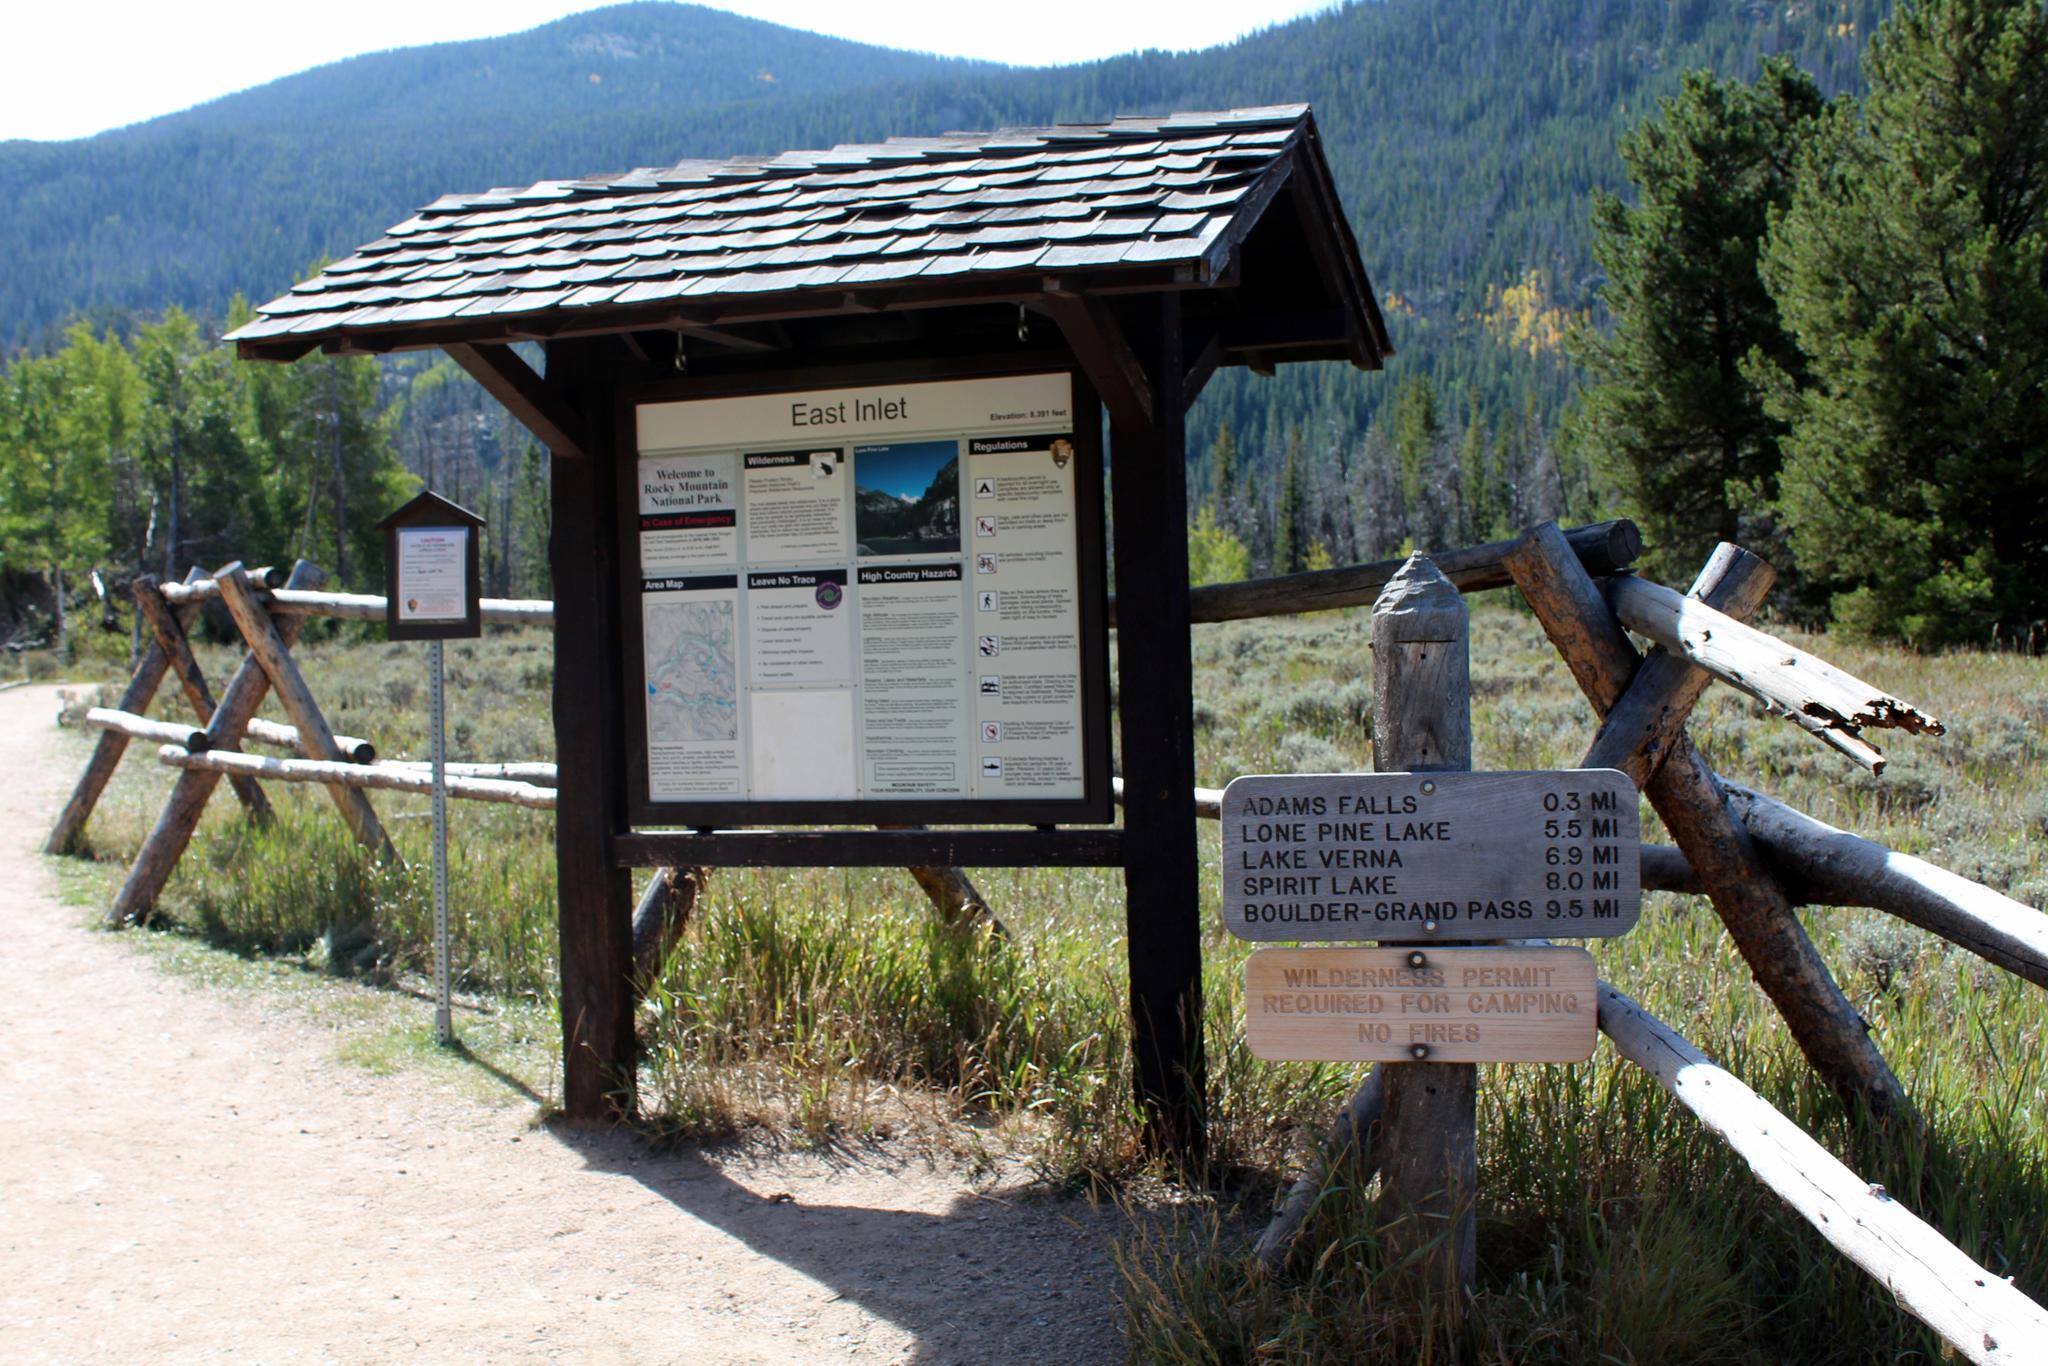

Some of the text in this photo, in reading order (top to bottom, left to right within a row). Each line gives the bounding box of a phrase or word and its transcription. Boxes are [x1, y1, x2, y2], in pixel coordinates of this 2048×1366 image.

[792, 397, 907, 426] East Inlet
[990, 412, 1026, 421] Elevation:
[1052, 409, 1067, 417] feet
[973, 439, 1028, 451] Regulations
[747, 454, 795, 465] Wilderness
[656, 469, 715, 480] Welcome to
[644, 480, 728, 496] Rocky Mountain
[652, 493, 722, 507] National Park
[652, 518, 673, 527] Case
[675, 517, 683, 526] of
[685, 516, 731, 526] Emergency
[751, 576, 816, 586] Leave No Trace
[862, 569, 958, 582] High Country Hazards
[645, 580, 684, 590] Area Map
[1242, 792, 1617, 816] ADAMS FALLS 0.3 MI
[1242, 818, 1618, 843] LONE PINE LAKE 5.5 MI
[1242, 846, 1619, 870] LAKE VERNA 6.9 MI
[1244, 871, 1619, 896] SPIRIT LAKE 8.0 MI
[1244, 899, 1619, 921] BOULDER-GRAND PASS 9.5 MI
[1284, 967, 1556, 988] WILDERNESS PERMIT
[1263, 994, 1579, 1014] REQUIRED FOR CAMPING
[1358, 1024, 1480, 1044] NO FIRES
